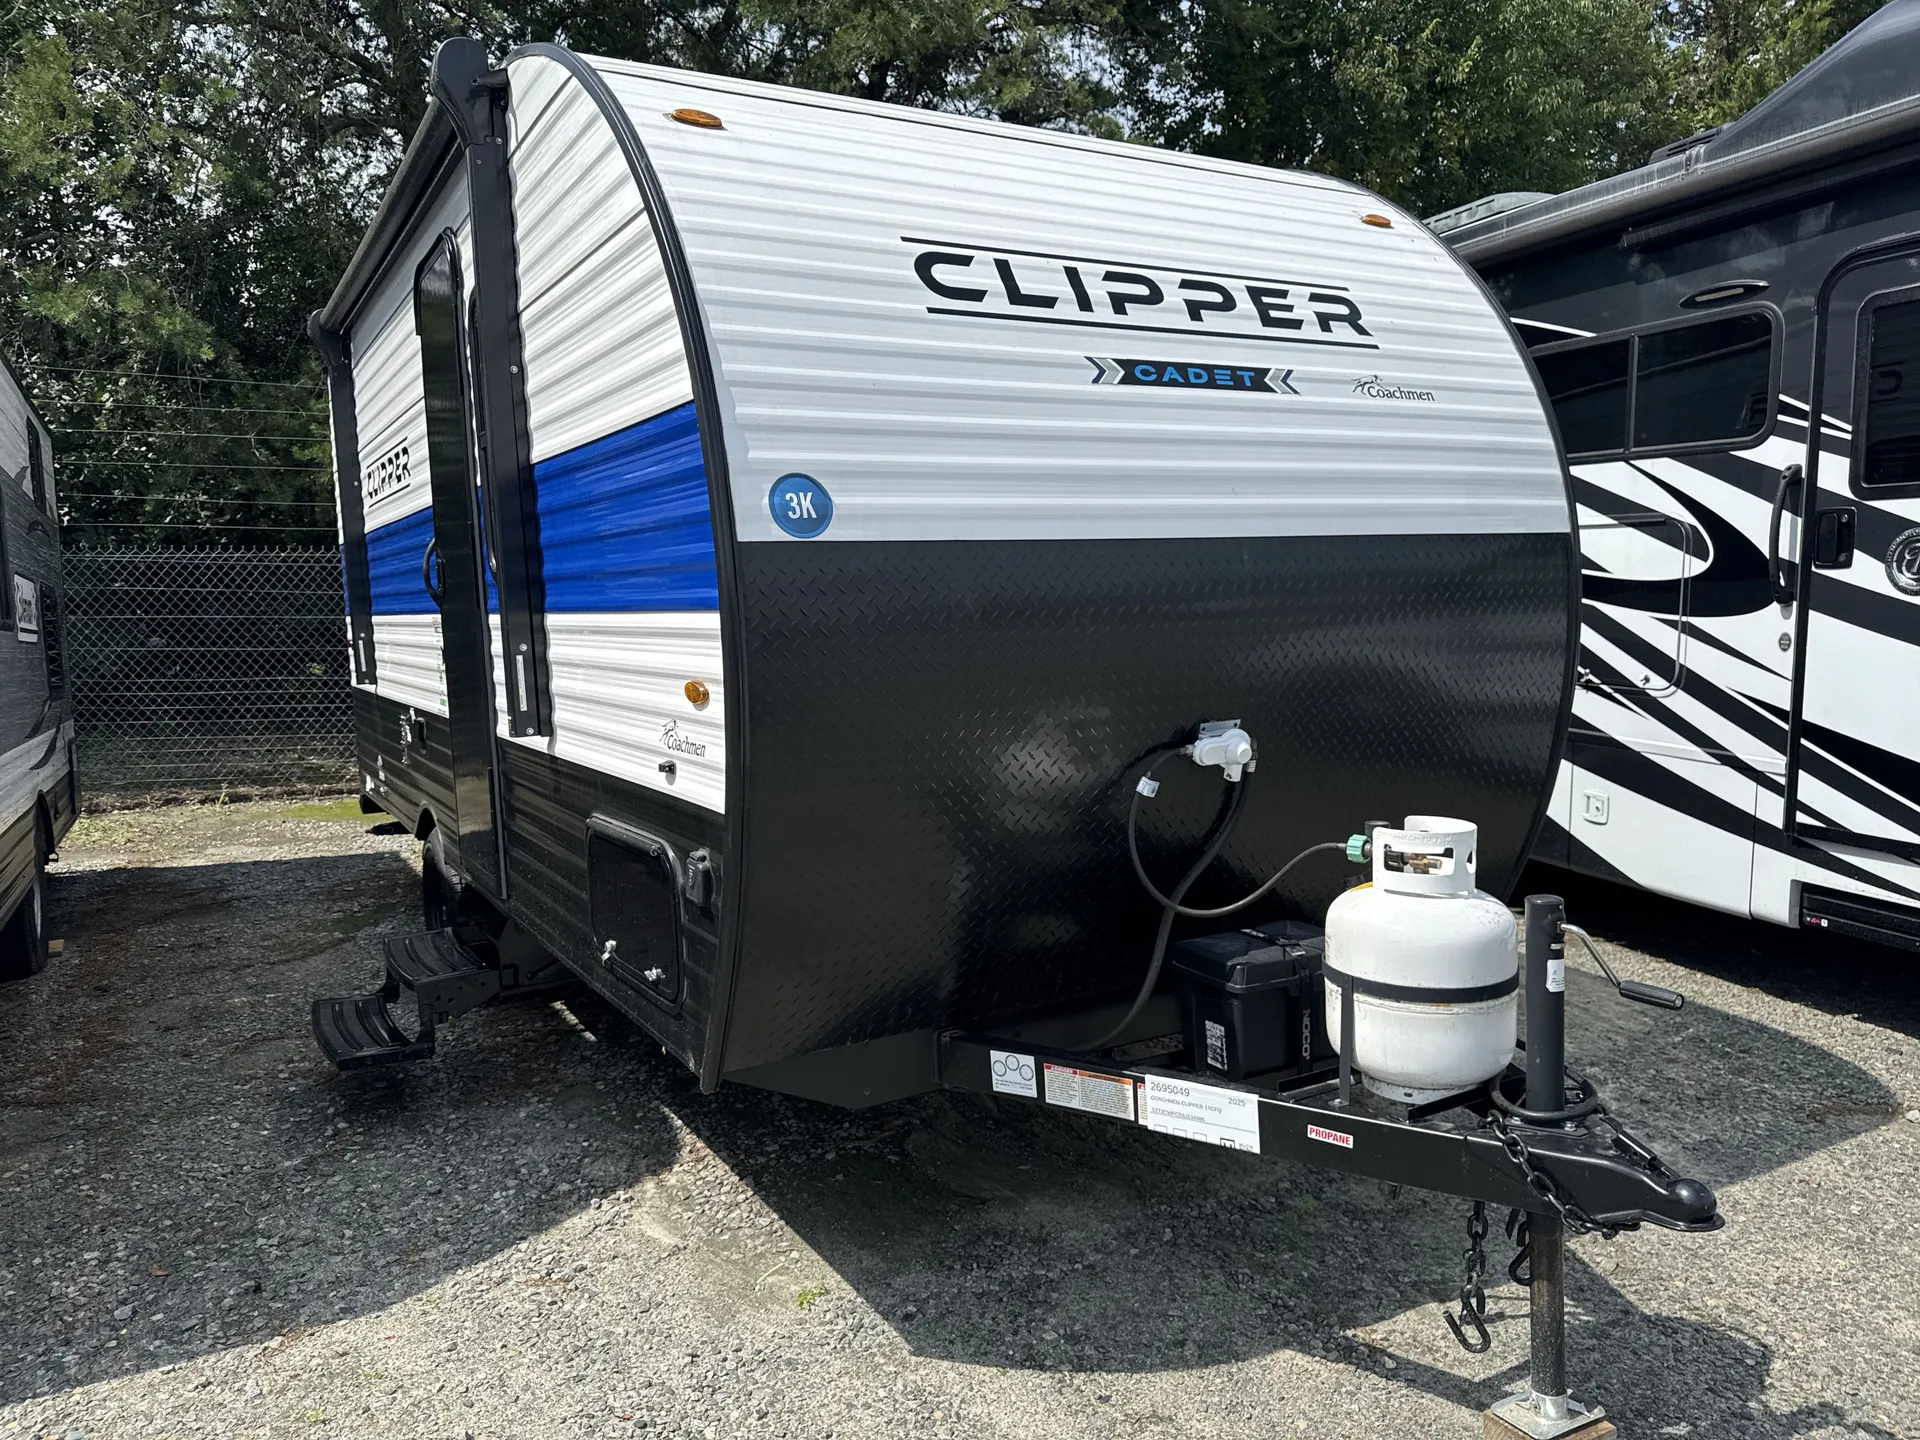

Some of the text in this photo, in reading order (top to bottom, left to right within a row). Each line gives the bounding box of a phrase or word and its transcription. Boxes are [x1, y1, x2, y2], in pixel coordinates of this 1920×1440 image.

[914, 251, 1374, 337] CLIPPER
[1134, 364, 1255, 387] CADET
[1367, 385, 1435, 402] Coachmen
[367, 446, 410, 498] CLIPPER
[785, 492, 817, 519] 3K
[667, 734, 706, 757] Coachmen
[1302, 1008, 1310, 1057] NOCO
[1150, 1081, 1190, 1097] 2695049
[1150, 1095, 1180, 1106] COACHMEN
[1181, 1100, 1204, 1110] CLIPPER
[1228, 1097, 1246, 1107] 2025
[1310, 1127, 1350, 1145] PROPANE
